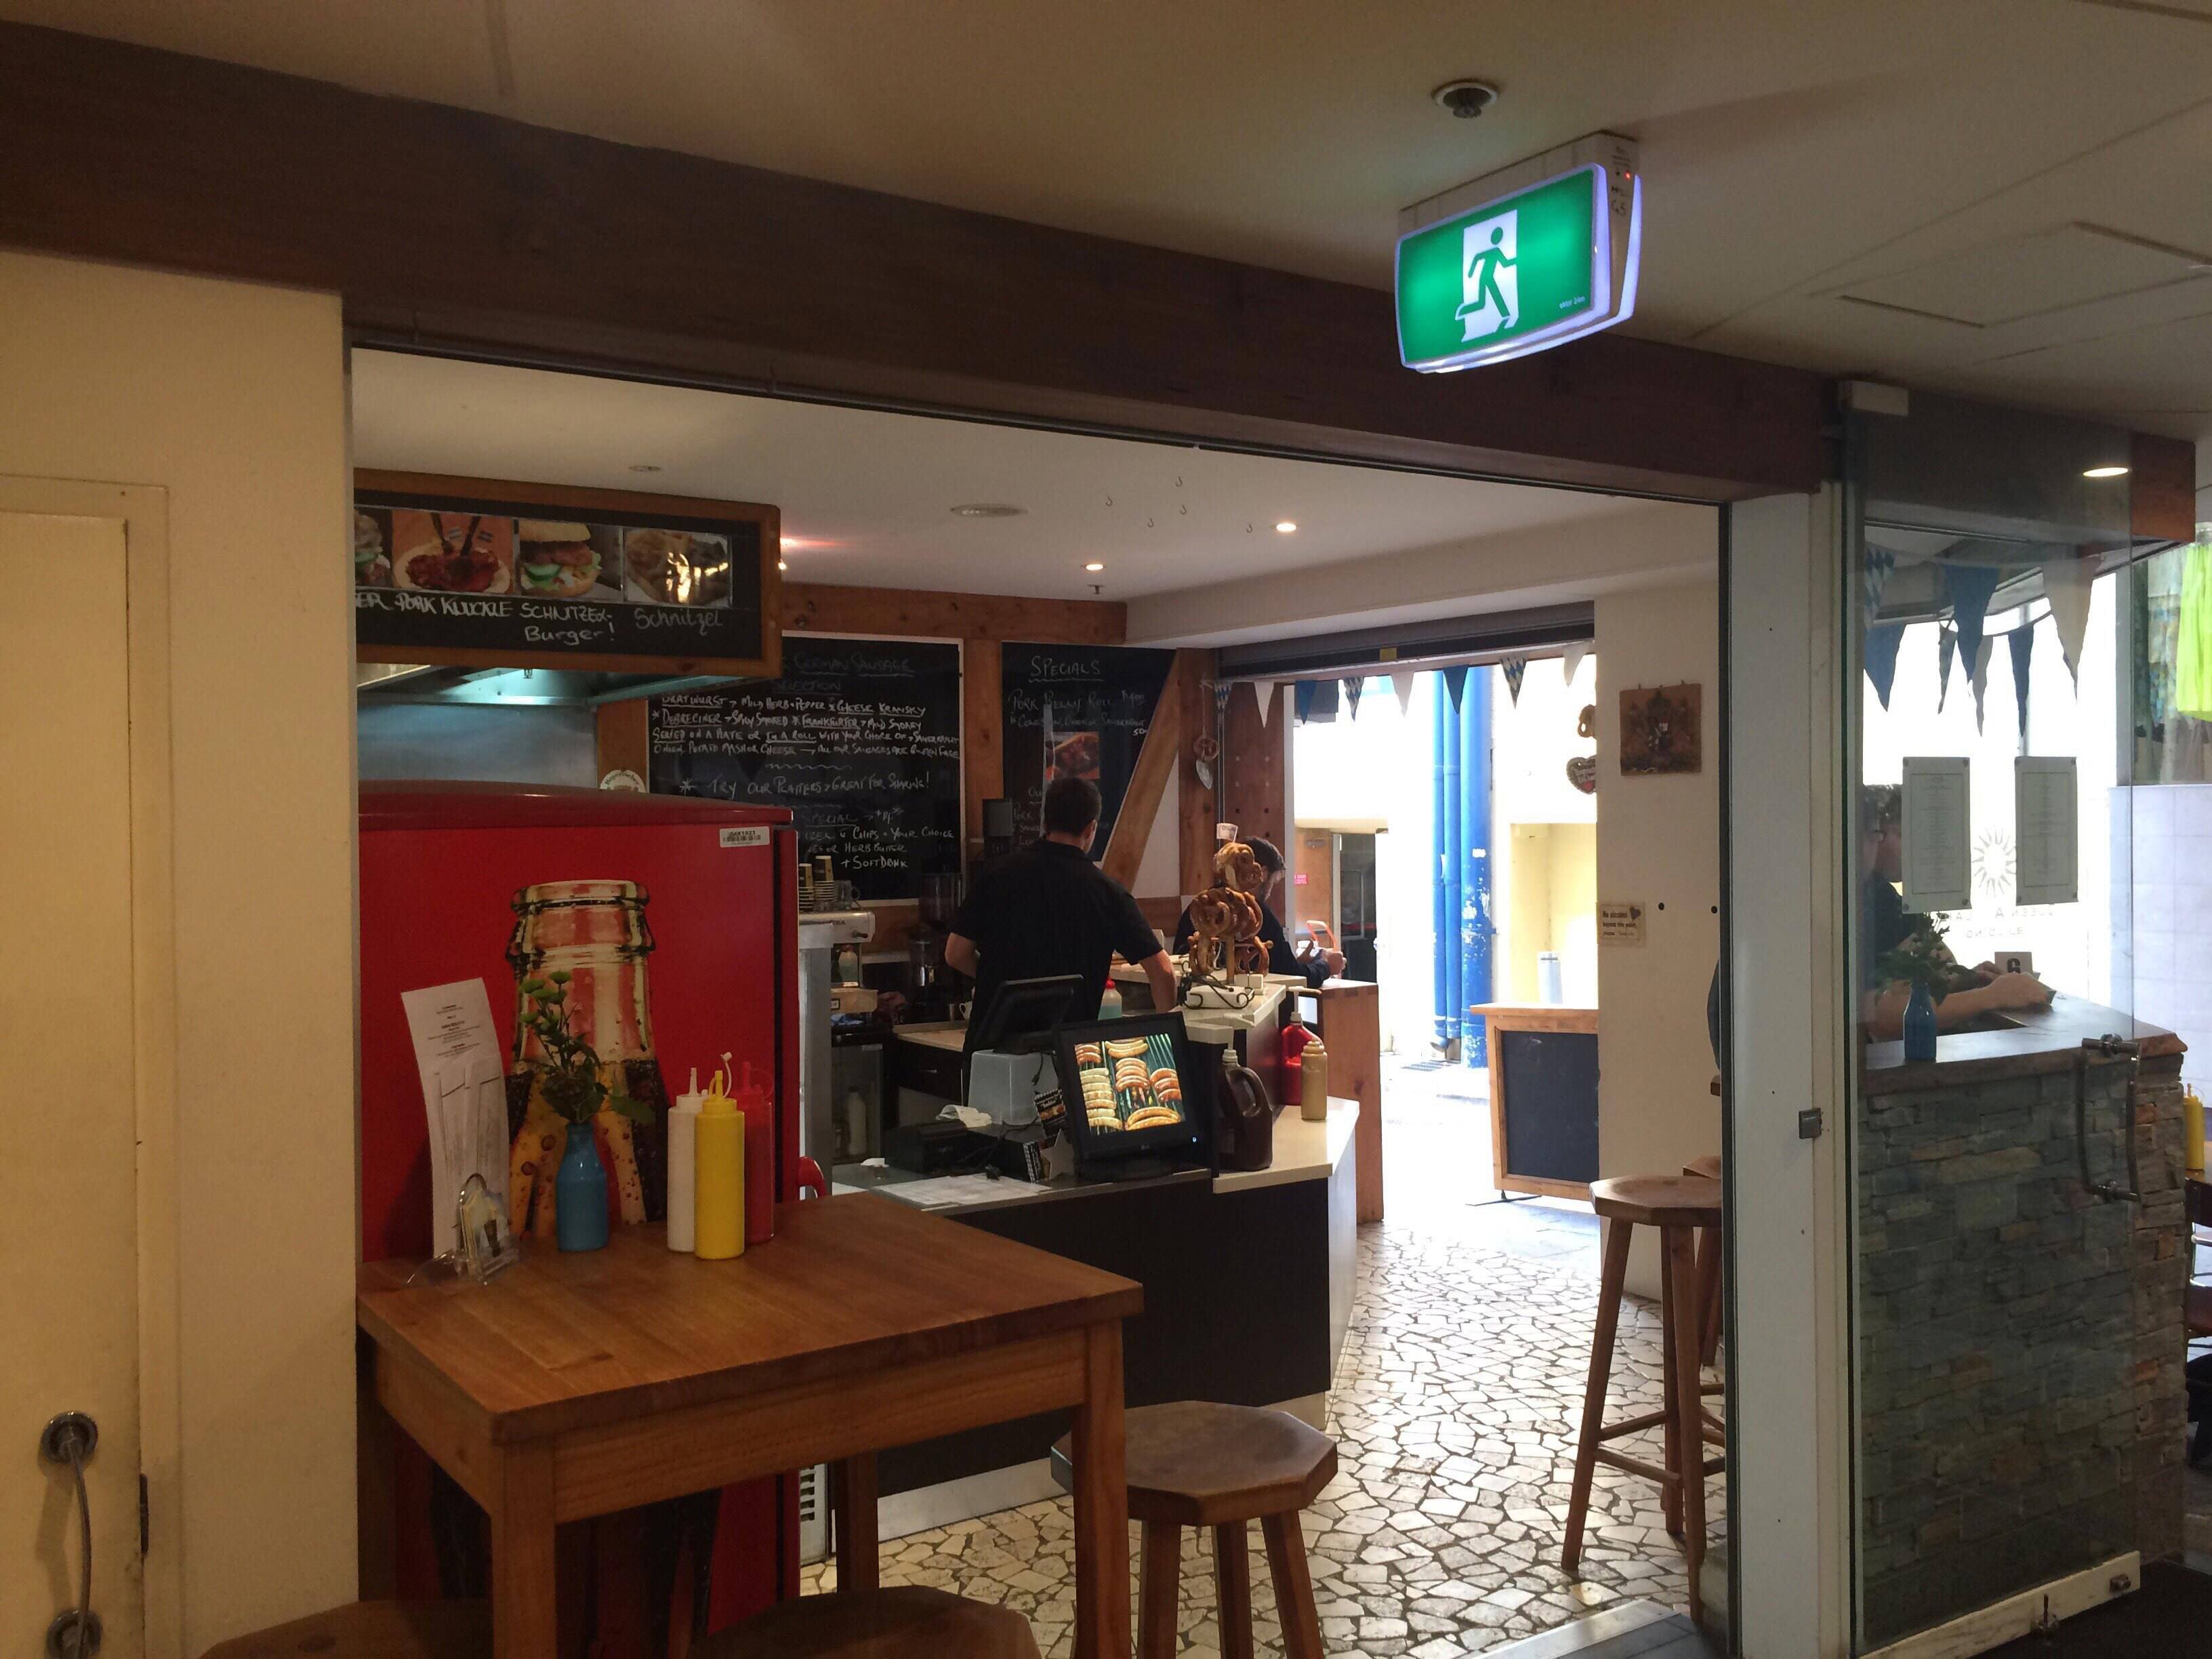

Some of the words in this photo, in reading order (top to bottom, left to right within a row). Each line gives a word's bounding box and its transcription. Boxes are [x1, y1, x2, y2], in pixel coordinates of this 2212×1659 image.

[394, 593, 438, 614] PORK
[634, 607, 724, 636] Schnitzel
[1030, 655, 1101, 678] SPECIALS
